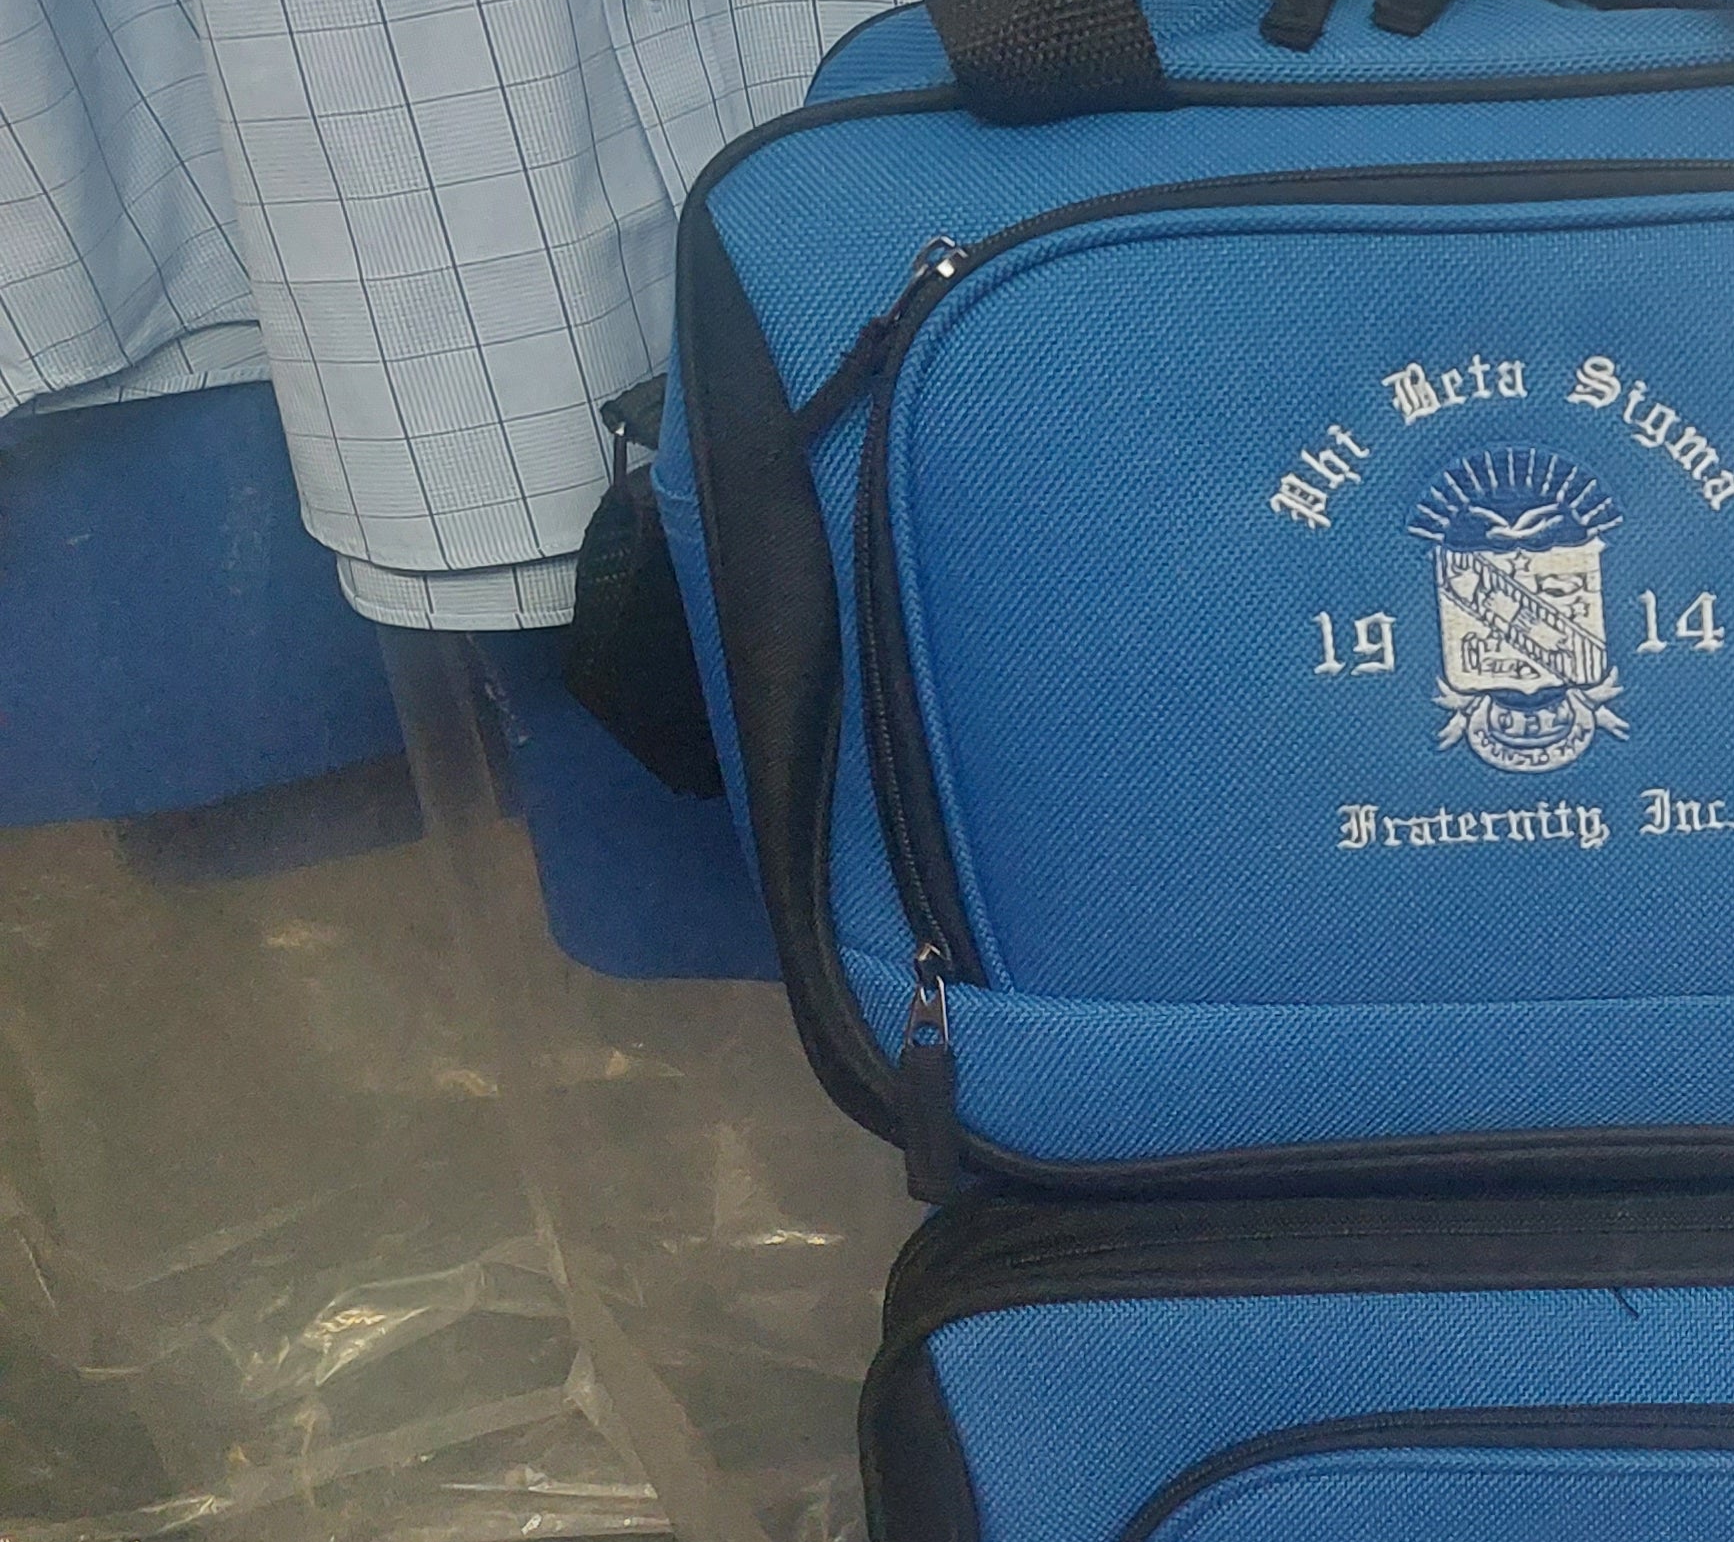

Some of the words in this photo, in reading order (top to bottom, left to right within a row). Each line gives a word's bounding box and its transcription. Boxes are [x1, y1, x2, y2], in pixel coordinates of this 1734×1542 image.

[1269, 424, 1370, 529] Phi
[1382, 354, 1528, 425] Beta
[1313, 611, 1396, 675] 19
[1636, 588, 1725, 653] 14
[1337, 800, 1610, 849] Fraternity
